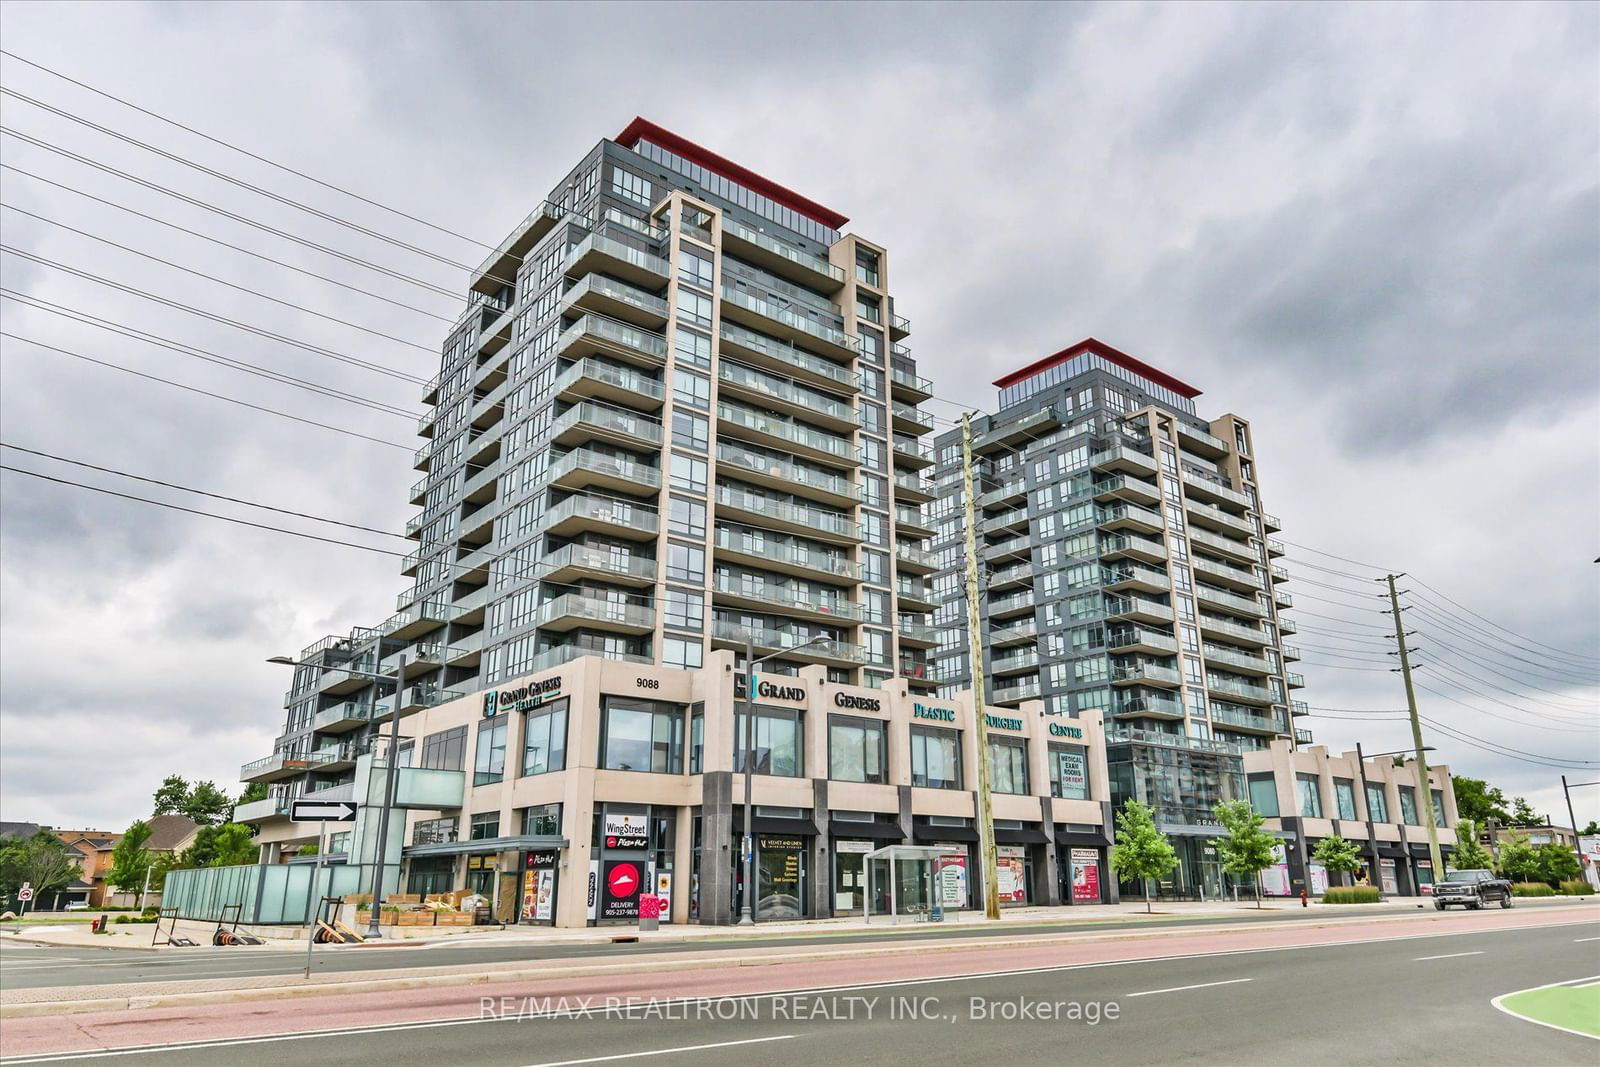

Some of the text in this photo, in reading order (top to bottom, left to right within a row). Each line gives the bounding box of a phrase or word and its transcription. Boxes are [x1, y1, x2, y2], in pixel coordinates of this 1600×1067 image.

[636, 677, 660, 690] 9088
[500, 676, 562, 705] GRAND GENESIS
[758, 681, 881, 712] GRAND GENESIS
[515, 696, 542, 712] HEALTH
[913, 703, 955, 722] PLASTIC
[1049, 722, 1083, 739] CENTRE
[1060, 755, 1082, 763] MEDICAL
[1064, 769, 1081, 777] ROOMS
[606, 823, 646, 835] WingStreet
[617, 838, 648, 847] Pizza Hut
